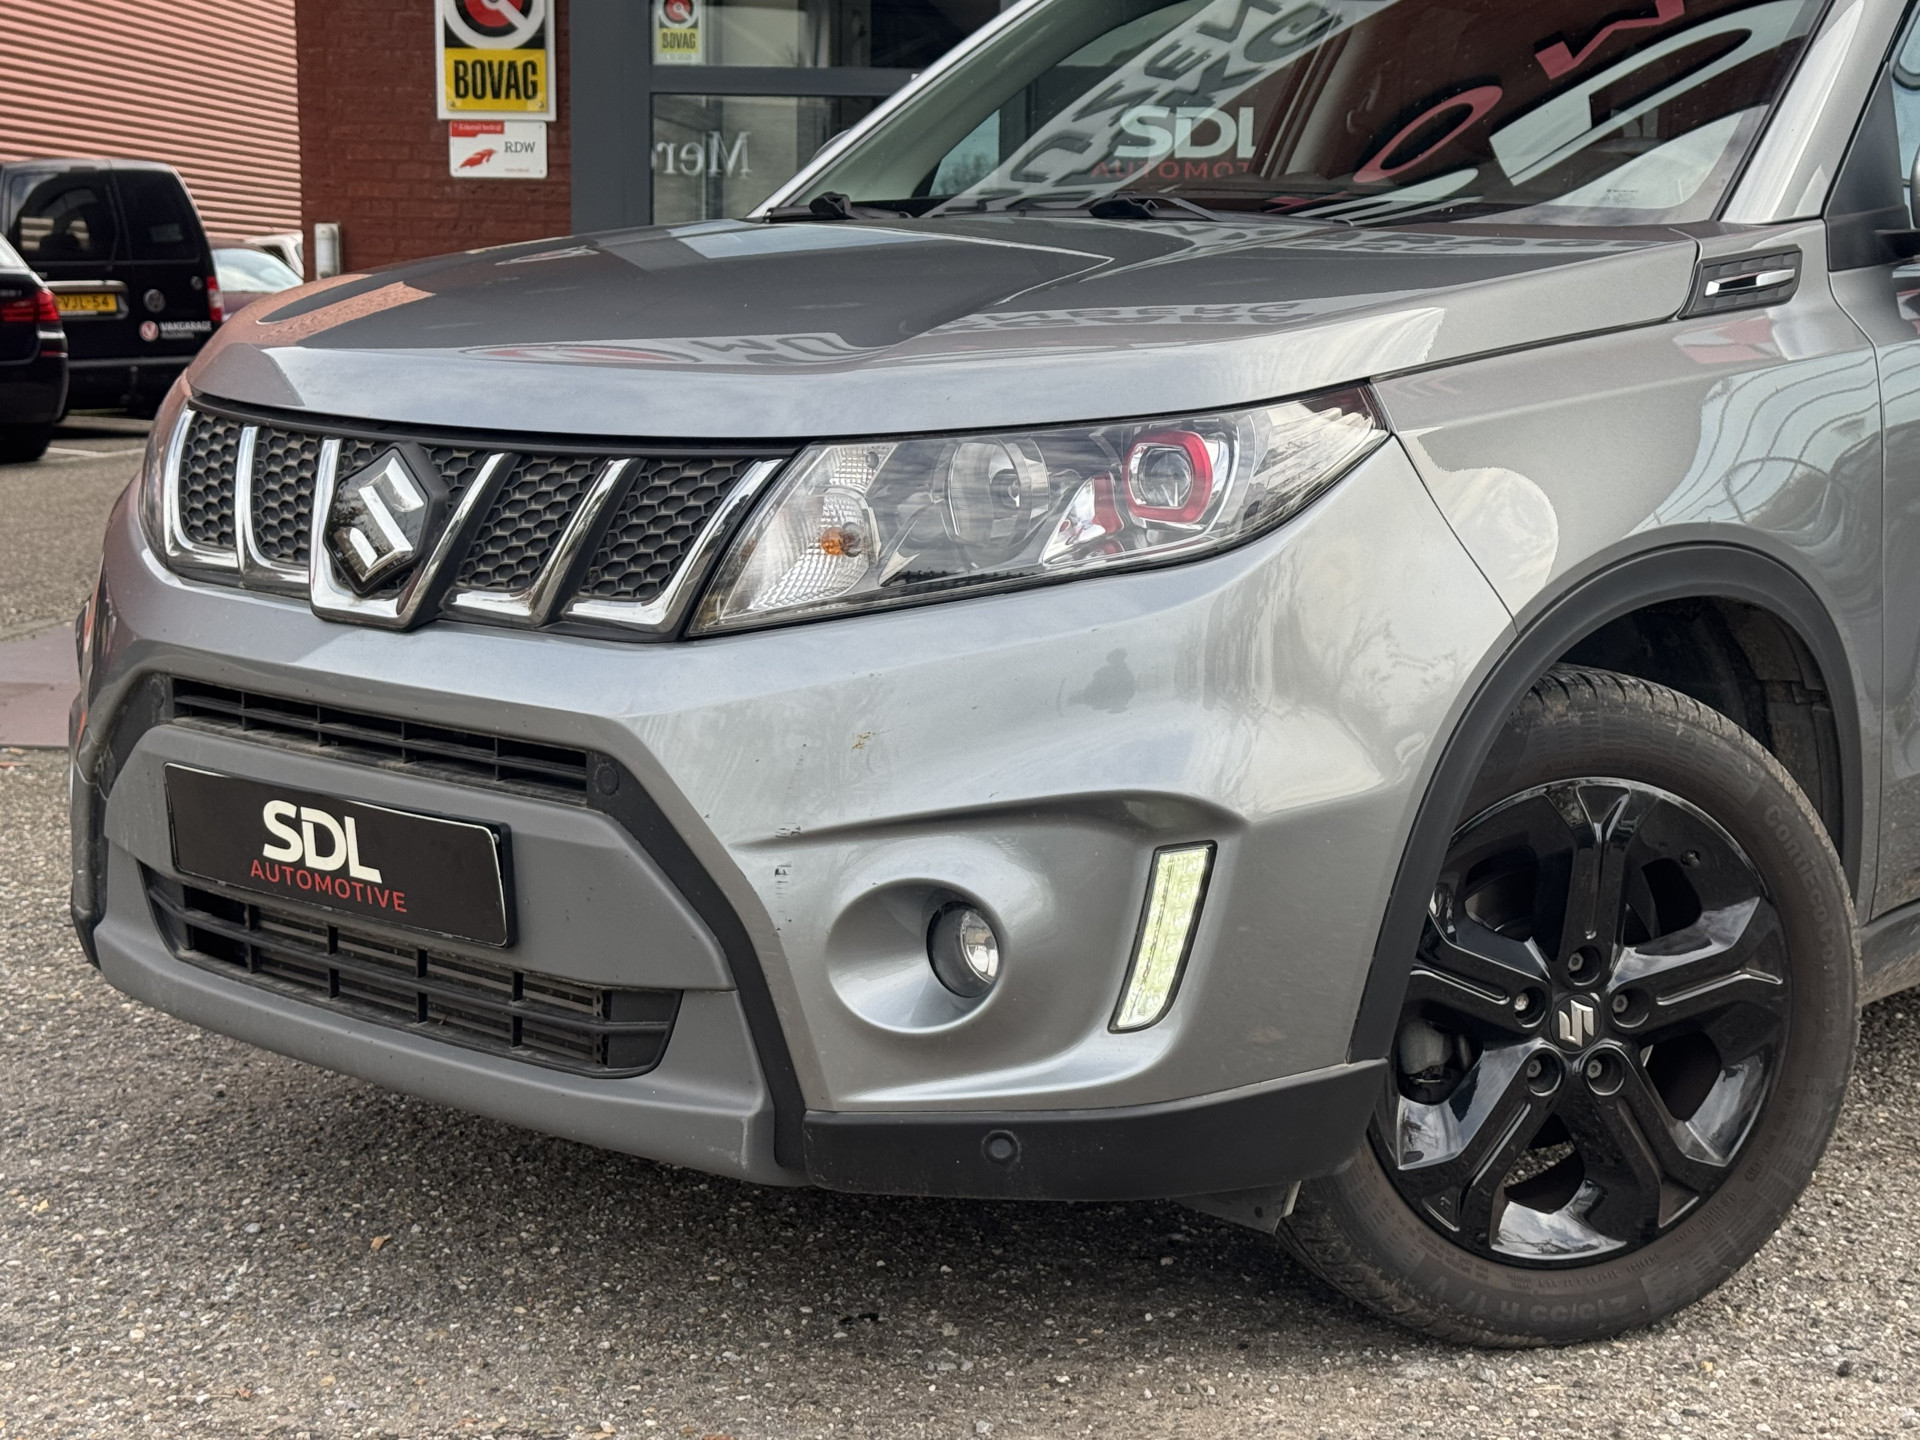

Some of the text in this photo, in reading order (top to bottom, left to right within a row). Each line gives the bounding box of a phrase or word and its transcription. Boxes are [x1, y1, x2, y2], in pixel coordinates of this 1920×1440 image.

[662, 31, 697, 50] BOVAG
[453, 59, 539, 100] BOVAG
[504, 141, 536, 154] RDW
[1113, 105, 1257, 159] SDL
[1090, 160, 1250, 180] AUTOMOT
[262, 799, 383, 884] SDL
[250, 858, 408, 913] AUTOMOTIVE
